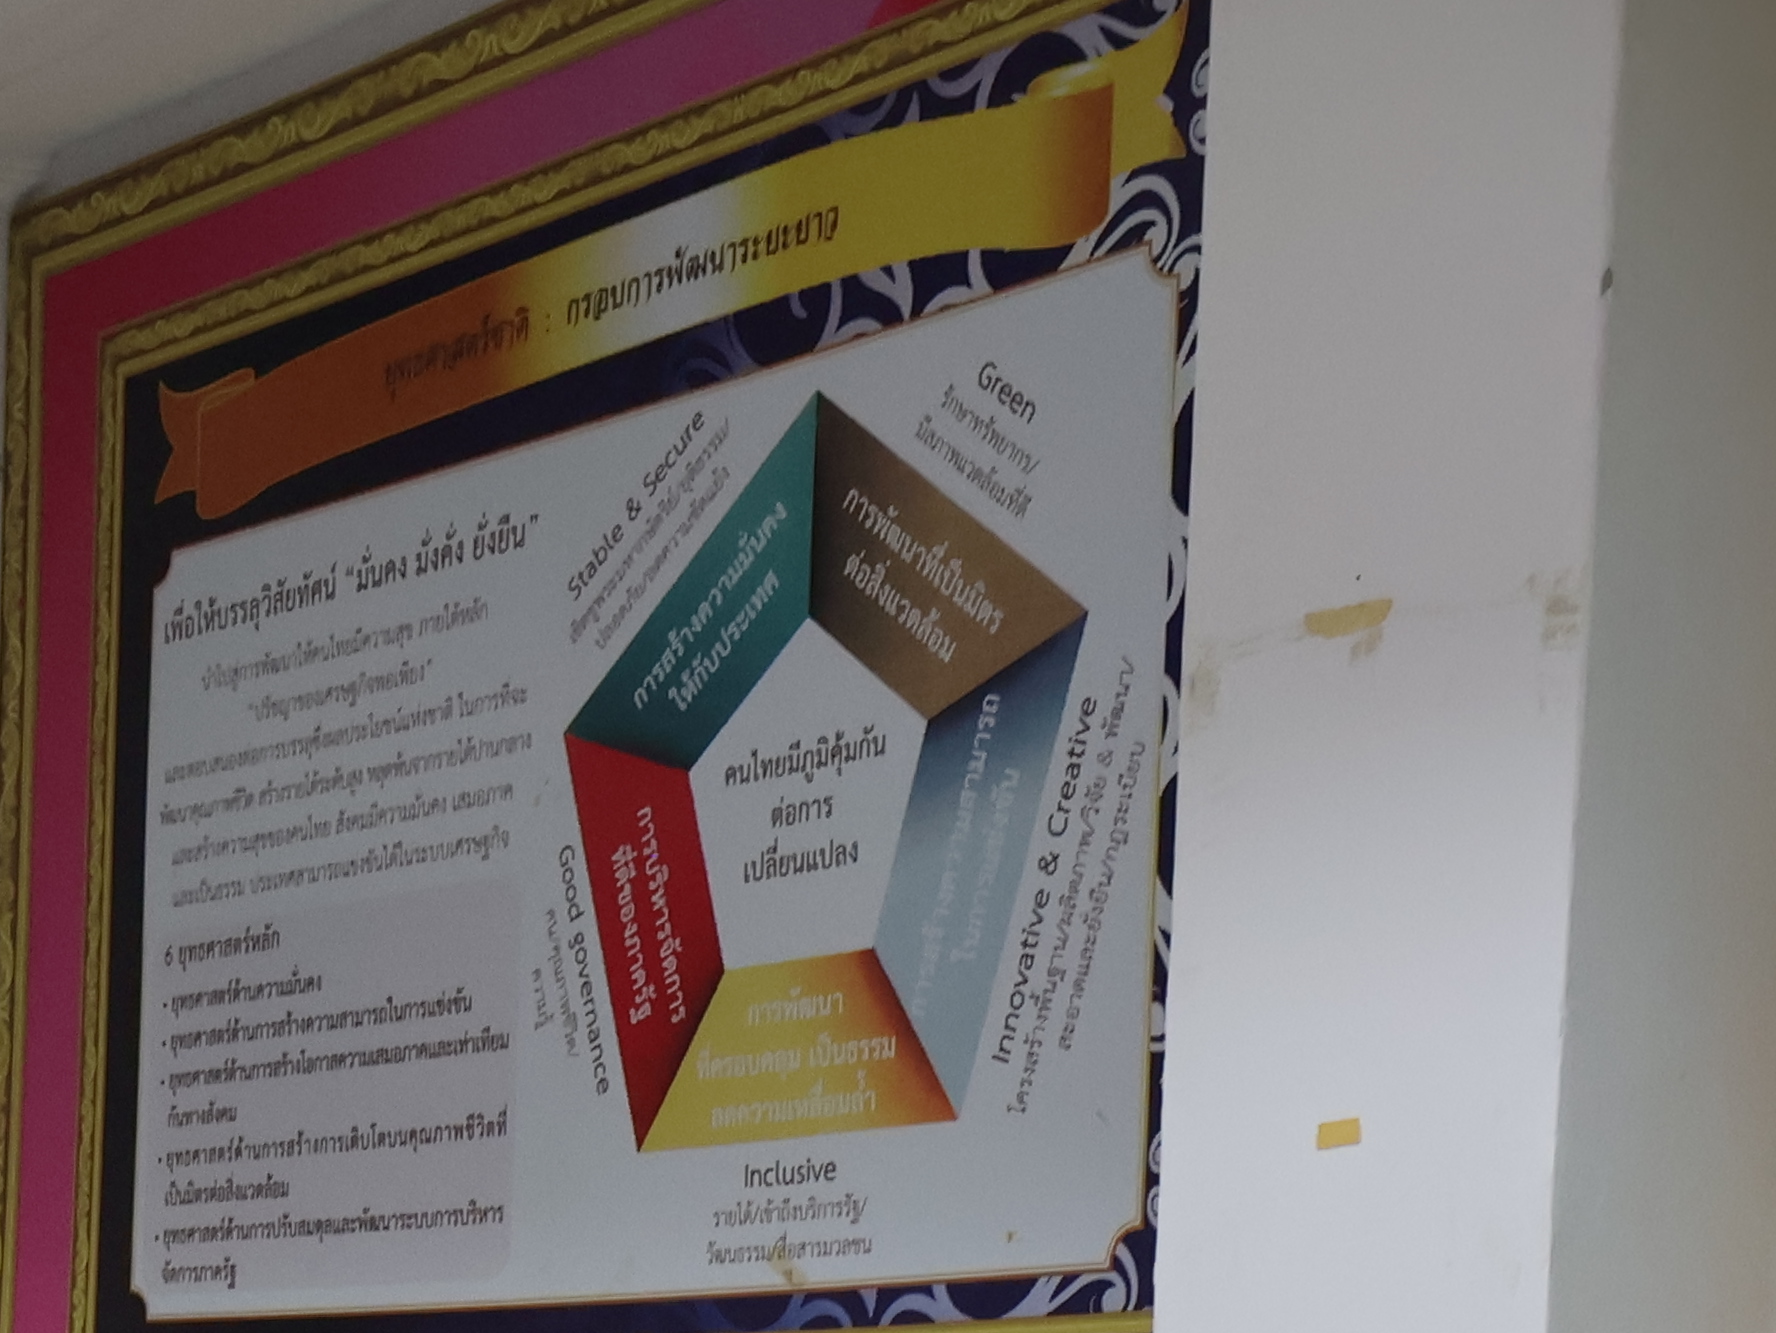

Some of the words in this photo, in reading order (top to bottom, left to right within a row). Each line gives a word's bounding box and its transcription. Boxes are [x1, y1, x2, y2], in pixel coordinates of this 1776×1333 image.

[566, 202, 840, 326] กรอบการพัฒนาระยะยาว
[977, 359, 1037, 426] Green
[567, 518, 625, 602] Stable
[625, 498, 644, 524] &
[641, 408, 707, 495] Secure
[163, 560, 338, 646] เพื่อให้บรรลุวิสัยทัศน์
[415, 522, 465, 578] มั่งคั่ง
[722, 730, 888, 790] คนไทยมีภูมิคุ้มกัน
[1047, 695, 1099, 838] Creative
[769, 794, 835, 831] ต่อการ
[556, 845, 586, 925] Good
[742, 842, 859, 886] เปลี่ยนแปลง
[1037, 848, 1062, 876] &
[163, 944, 174, 967] 6
[177, 923, 281, 973] ยุทธศาสตร์หลัก
[991, 887, 1052, 1066] Innovative
[570, 930, 610, 1098] governance
[743, 1156, 838, 1189] Inclusive
